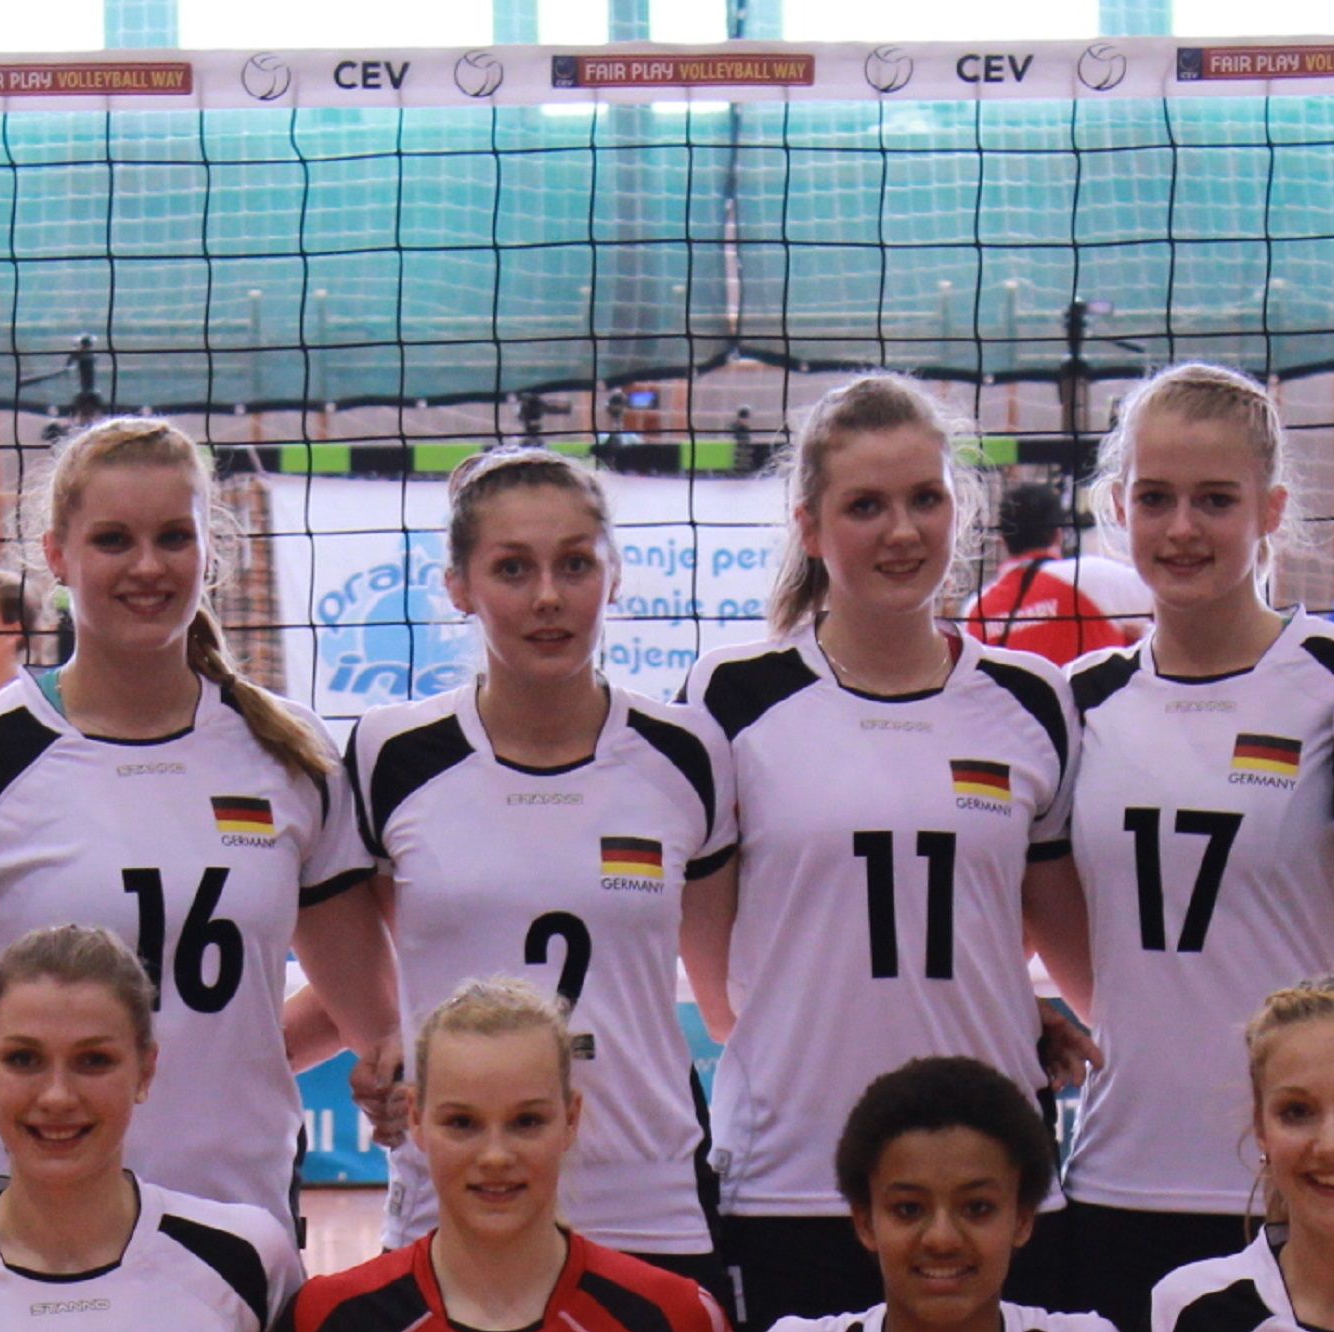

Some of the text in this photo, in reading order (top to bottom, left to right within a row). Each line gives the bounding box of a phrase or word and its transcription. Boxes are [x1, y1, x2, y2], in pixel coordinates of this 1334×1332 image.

[584, 62, 807, 80] FAIR PLAY VOLLEYBALL WAY
[956, 54, 1034, 83] CEV
[1210, 55, 1251, 72] FAIR
[1257, 54, 1299, 72] PLAY
[10, 72, 52, 89] PLAY
[57, 72, 148, 88] VOLLEYBALL
[151, 71, 185, 87] WAY
[333, 60, 410, 89] CEV
[1228, 772, 1297, 791] GERMANY
[601, 877, 665, 894] GERMANY
[1123, 807, 1245, 953] 17
[853, 830, 957, 980] 11
[122, 866, 245, 1014] 16
[30, 1299, 112, 1316] STANNO
